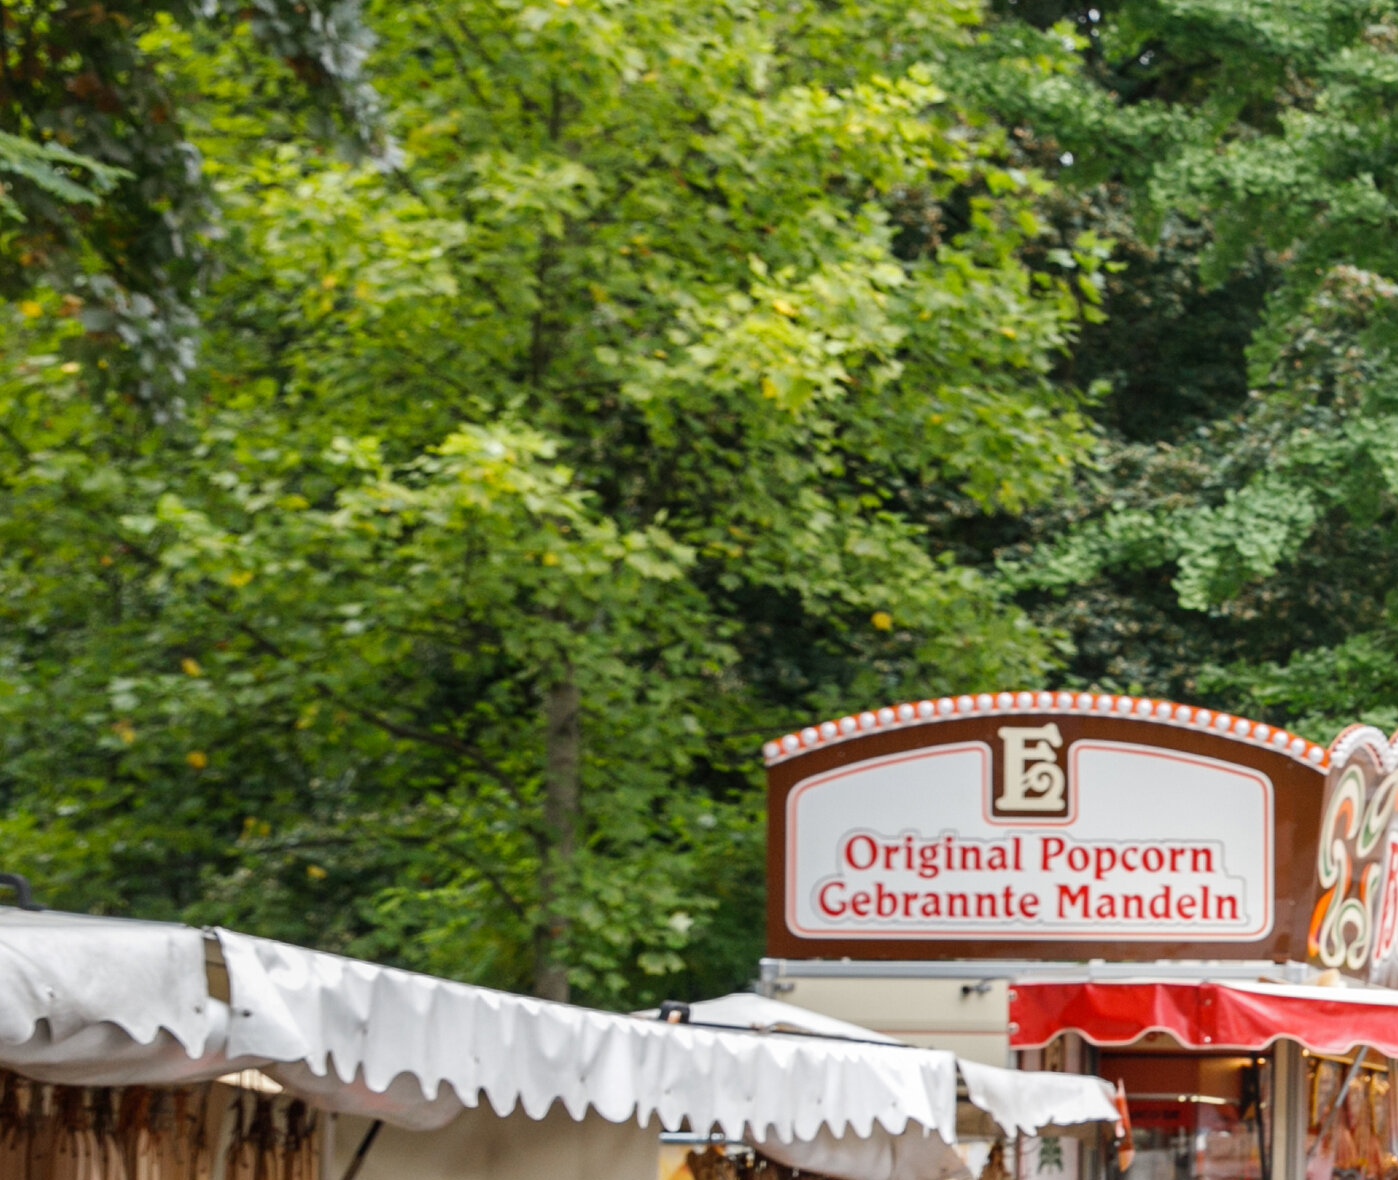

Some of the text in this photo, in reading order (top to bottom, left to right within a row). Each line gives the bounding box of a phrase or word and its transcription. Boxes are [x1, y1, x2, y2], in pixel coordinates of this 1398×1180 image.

[844, 833, 1215, 880] Original Popcorn
[818, 880, 1240, 921] Gebrannte Mandeln
